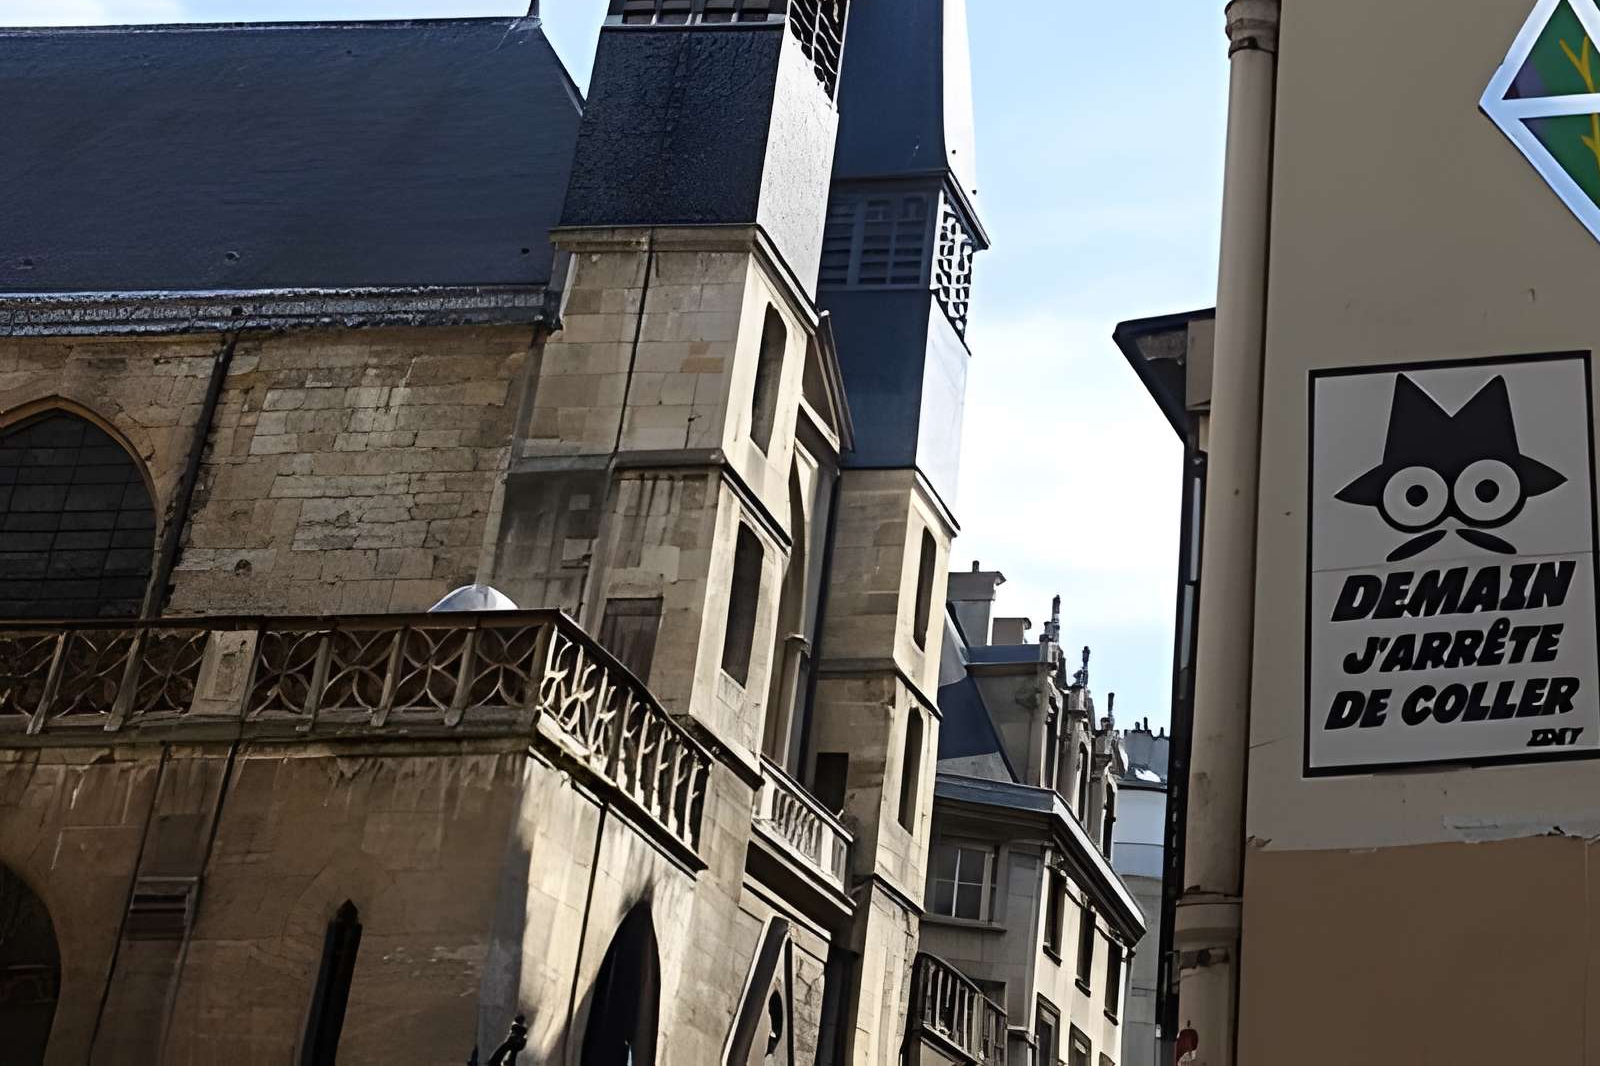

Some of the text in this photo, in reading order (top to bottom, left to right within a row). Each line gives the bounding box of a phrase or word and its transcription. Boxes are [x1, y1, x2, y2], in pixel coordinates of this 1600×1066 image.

[1330, 560, 1577, 622] DEMAIN
[1324, 677, 1580, 730] DE COLLER
